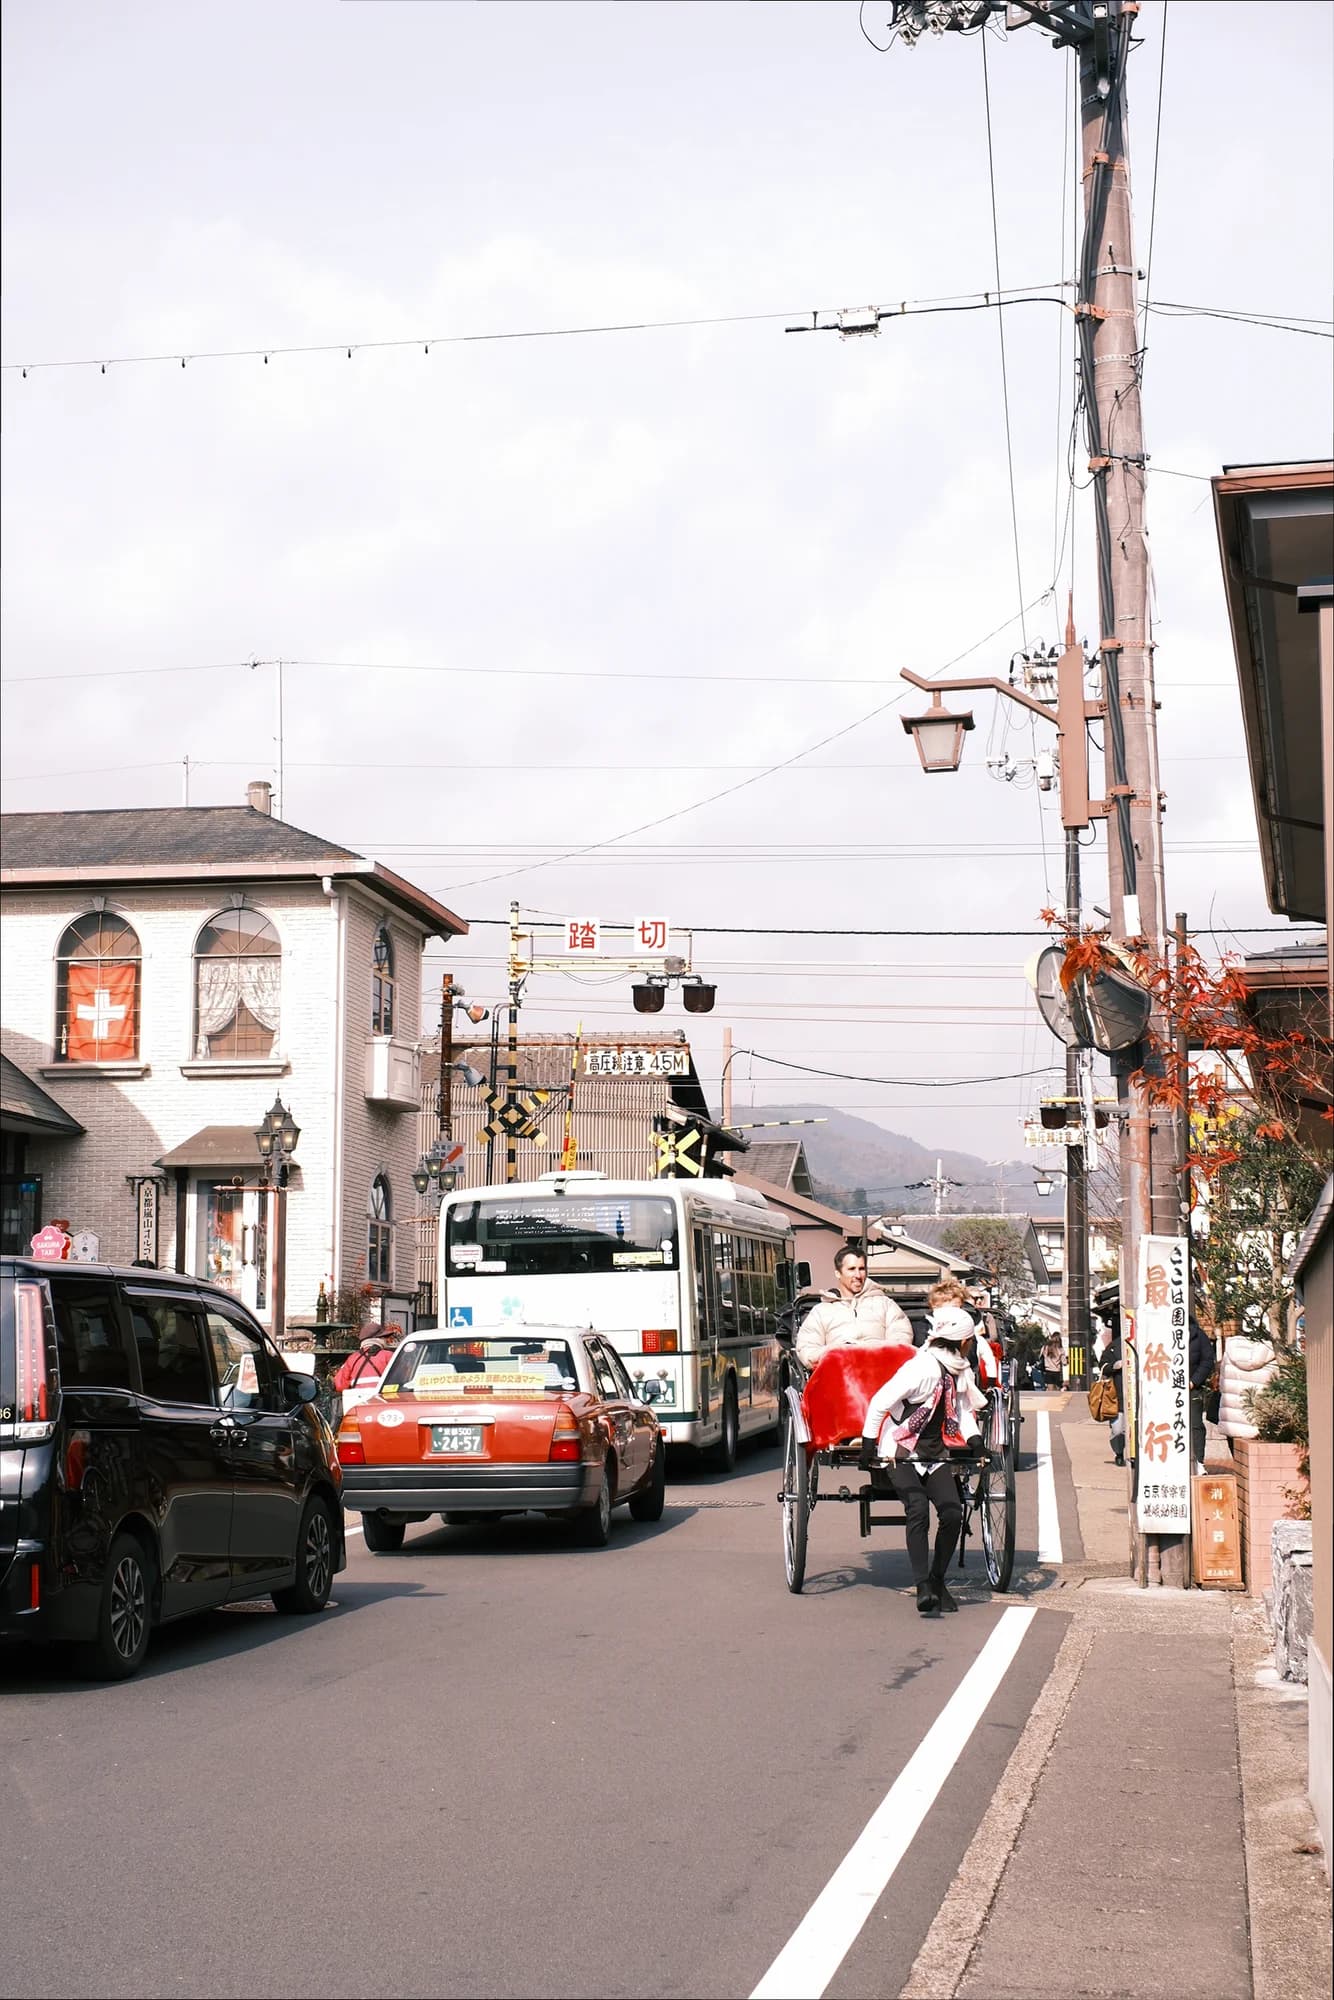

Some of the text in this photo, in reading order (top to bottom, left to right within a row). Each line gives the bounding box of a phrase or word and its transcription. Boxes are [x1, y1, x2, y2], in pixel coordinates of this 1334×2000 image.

[568, 920, 666, 949] 踏切
[588, 1054, 684, 1071] 高圧線注意 4.5M
[1143, 1264, 1174, 1463] 最徐行
[1170, 1246, 1187, 1454] ここは園児の通るみち
[1209, 1487, 1225, 1543] 消火器
